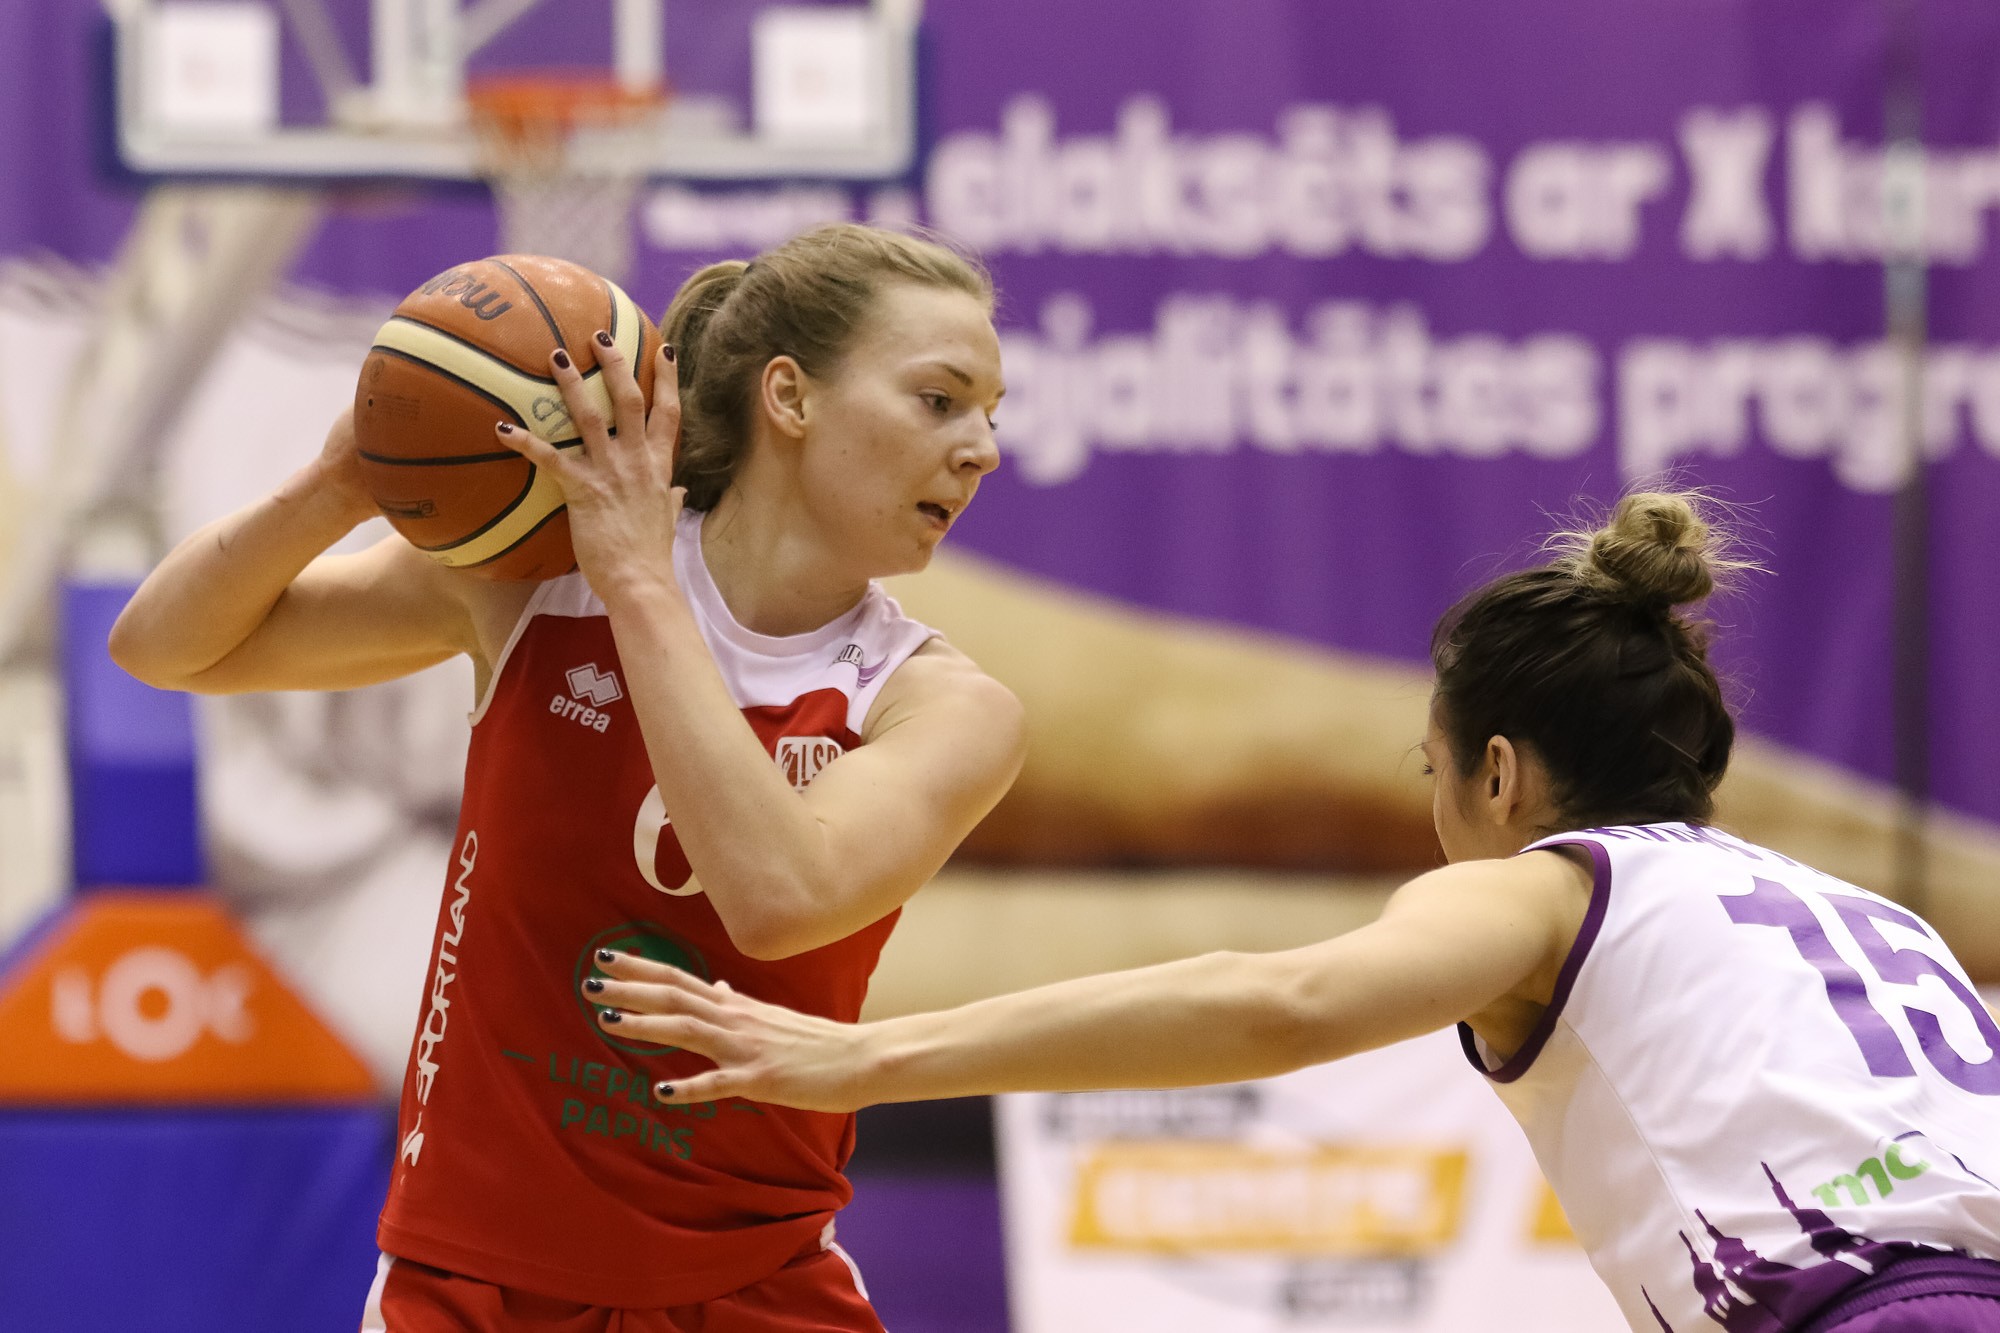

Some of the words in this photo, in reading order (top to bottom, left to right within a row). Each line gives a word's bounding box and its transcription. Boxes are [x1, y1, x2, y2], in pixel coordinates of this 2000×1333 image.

[1678, 106, 1774, 261] X
[549, 694, 612, 734] errea
[416, 830, 479, 1106] SPORTLAND
[1716, 875, 2000, 1096] 15
